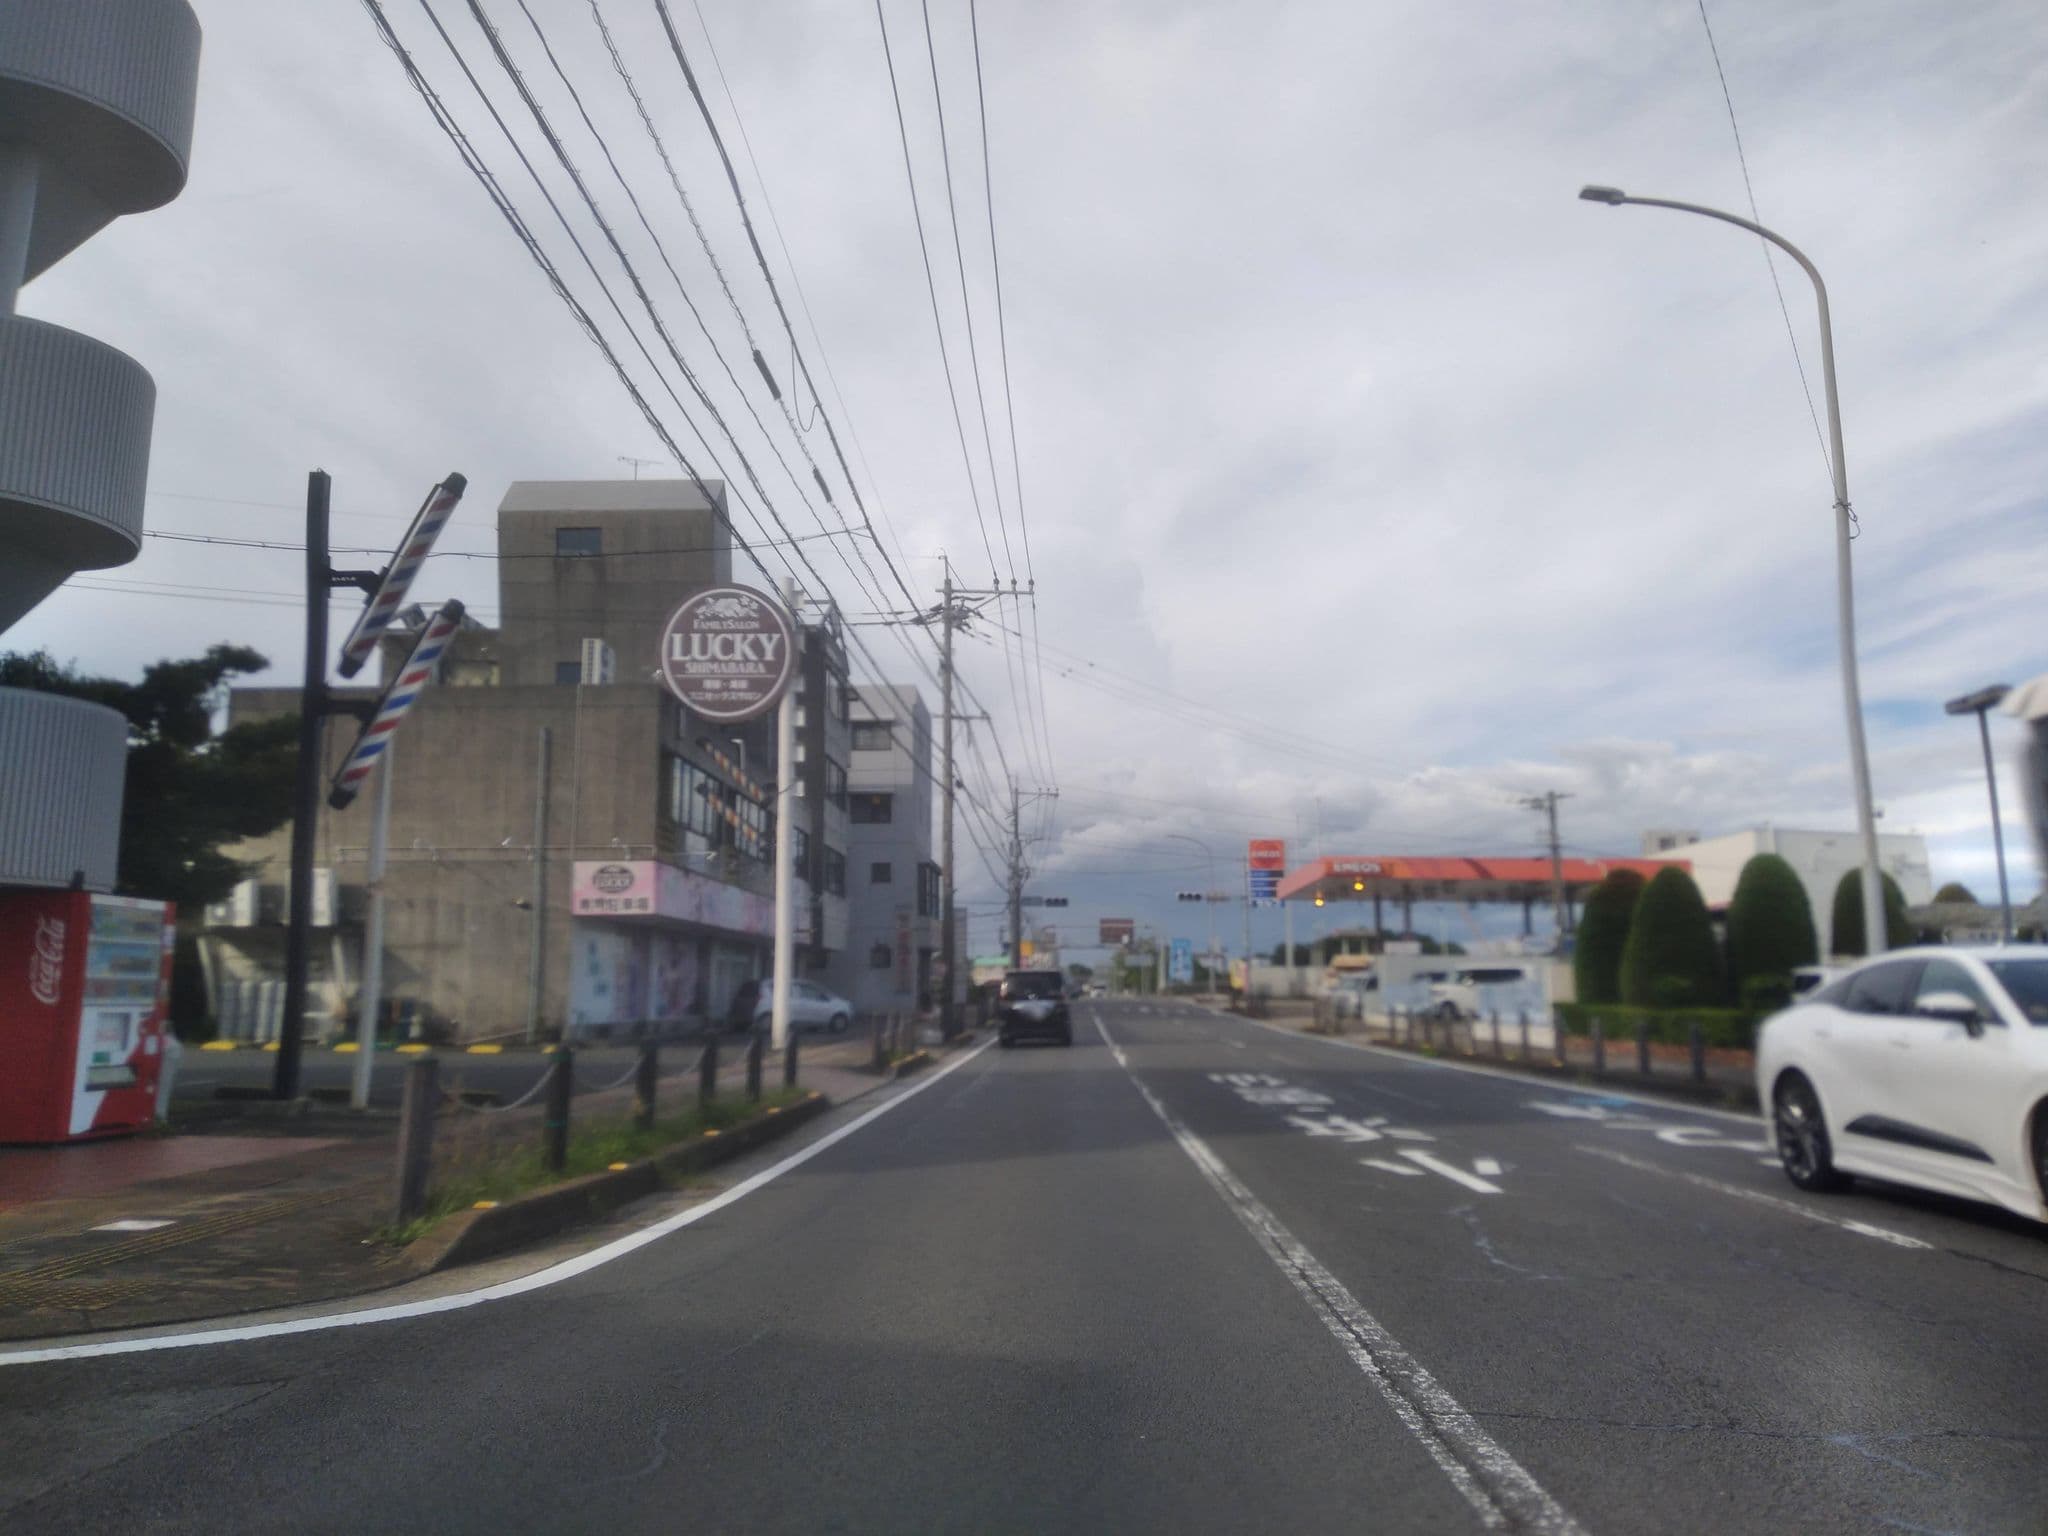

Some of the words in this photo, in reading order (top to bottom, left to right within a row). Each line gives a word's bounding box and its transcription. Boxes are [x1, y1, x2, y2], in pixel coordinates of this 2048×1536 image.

[671, 633, 781, 661] LUCKY
[1333, 862, 1381, 873] ENEOS
[30, 916, 65, 1004] Coca-Cola
